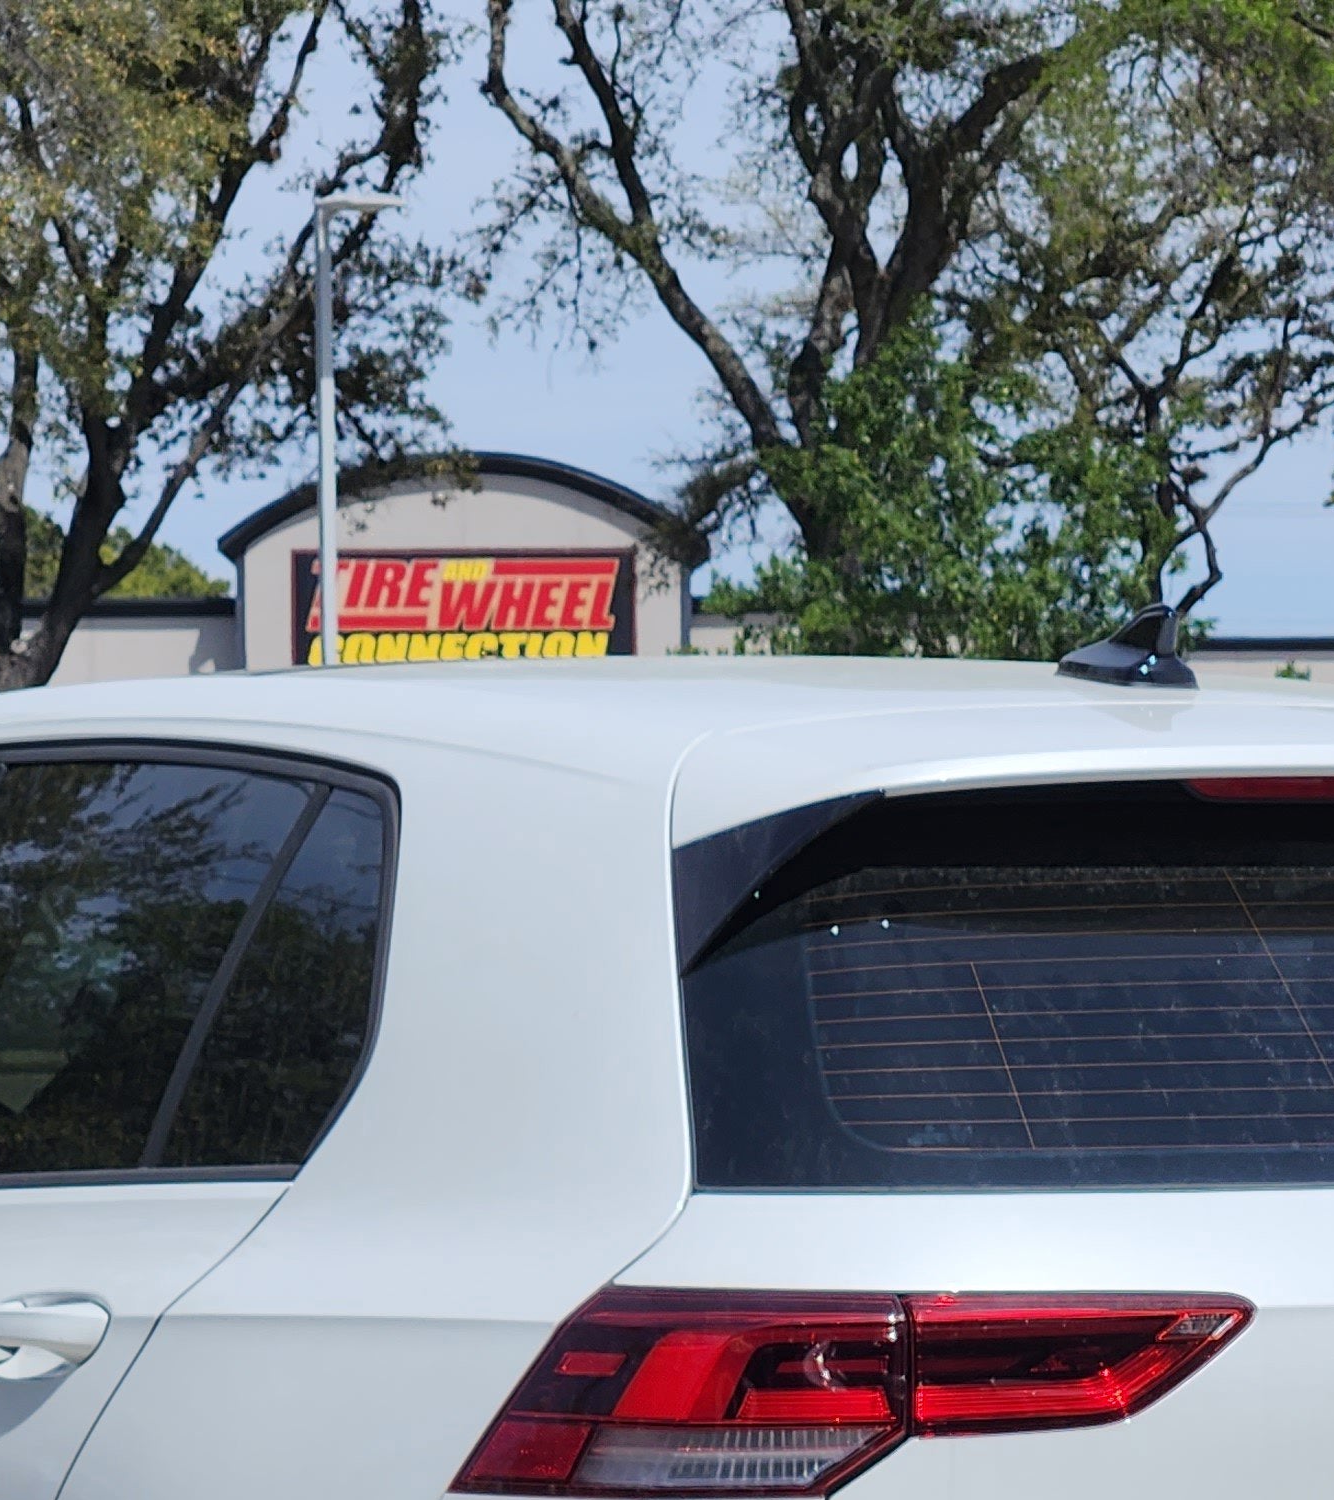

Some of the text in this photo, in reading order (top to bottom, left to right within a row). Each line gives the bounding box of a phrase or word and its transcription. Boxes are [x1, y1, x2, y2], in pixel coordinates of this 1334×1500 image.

[311, 558, 489, 609] IRE AND
[438, 580, 614, 629] WHEEL
